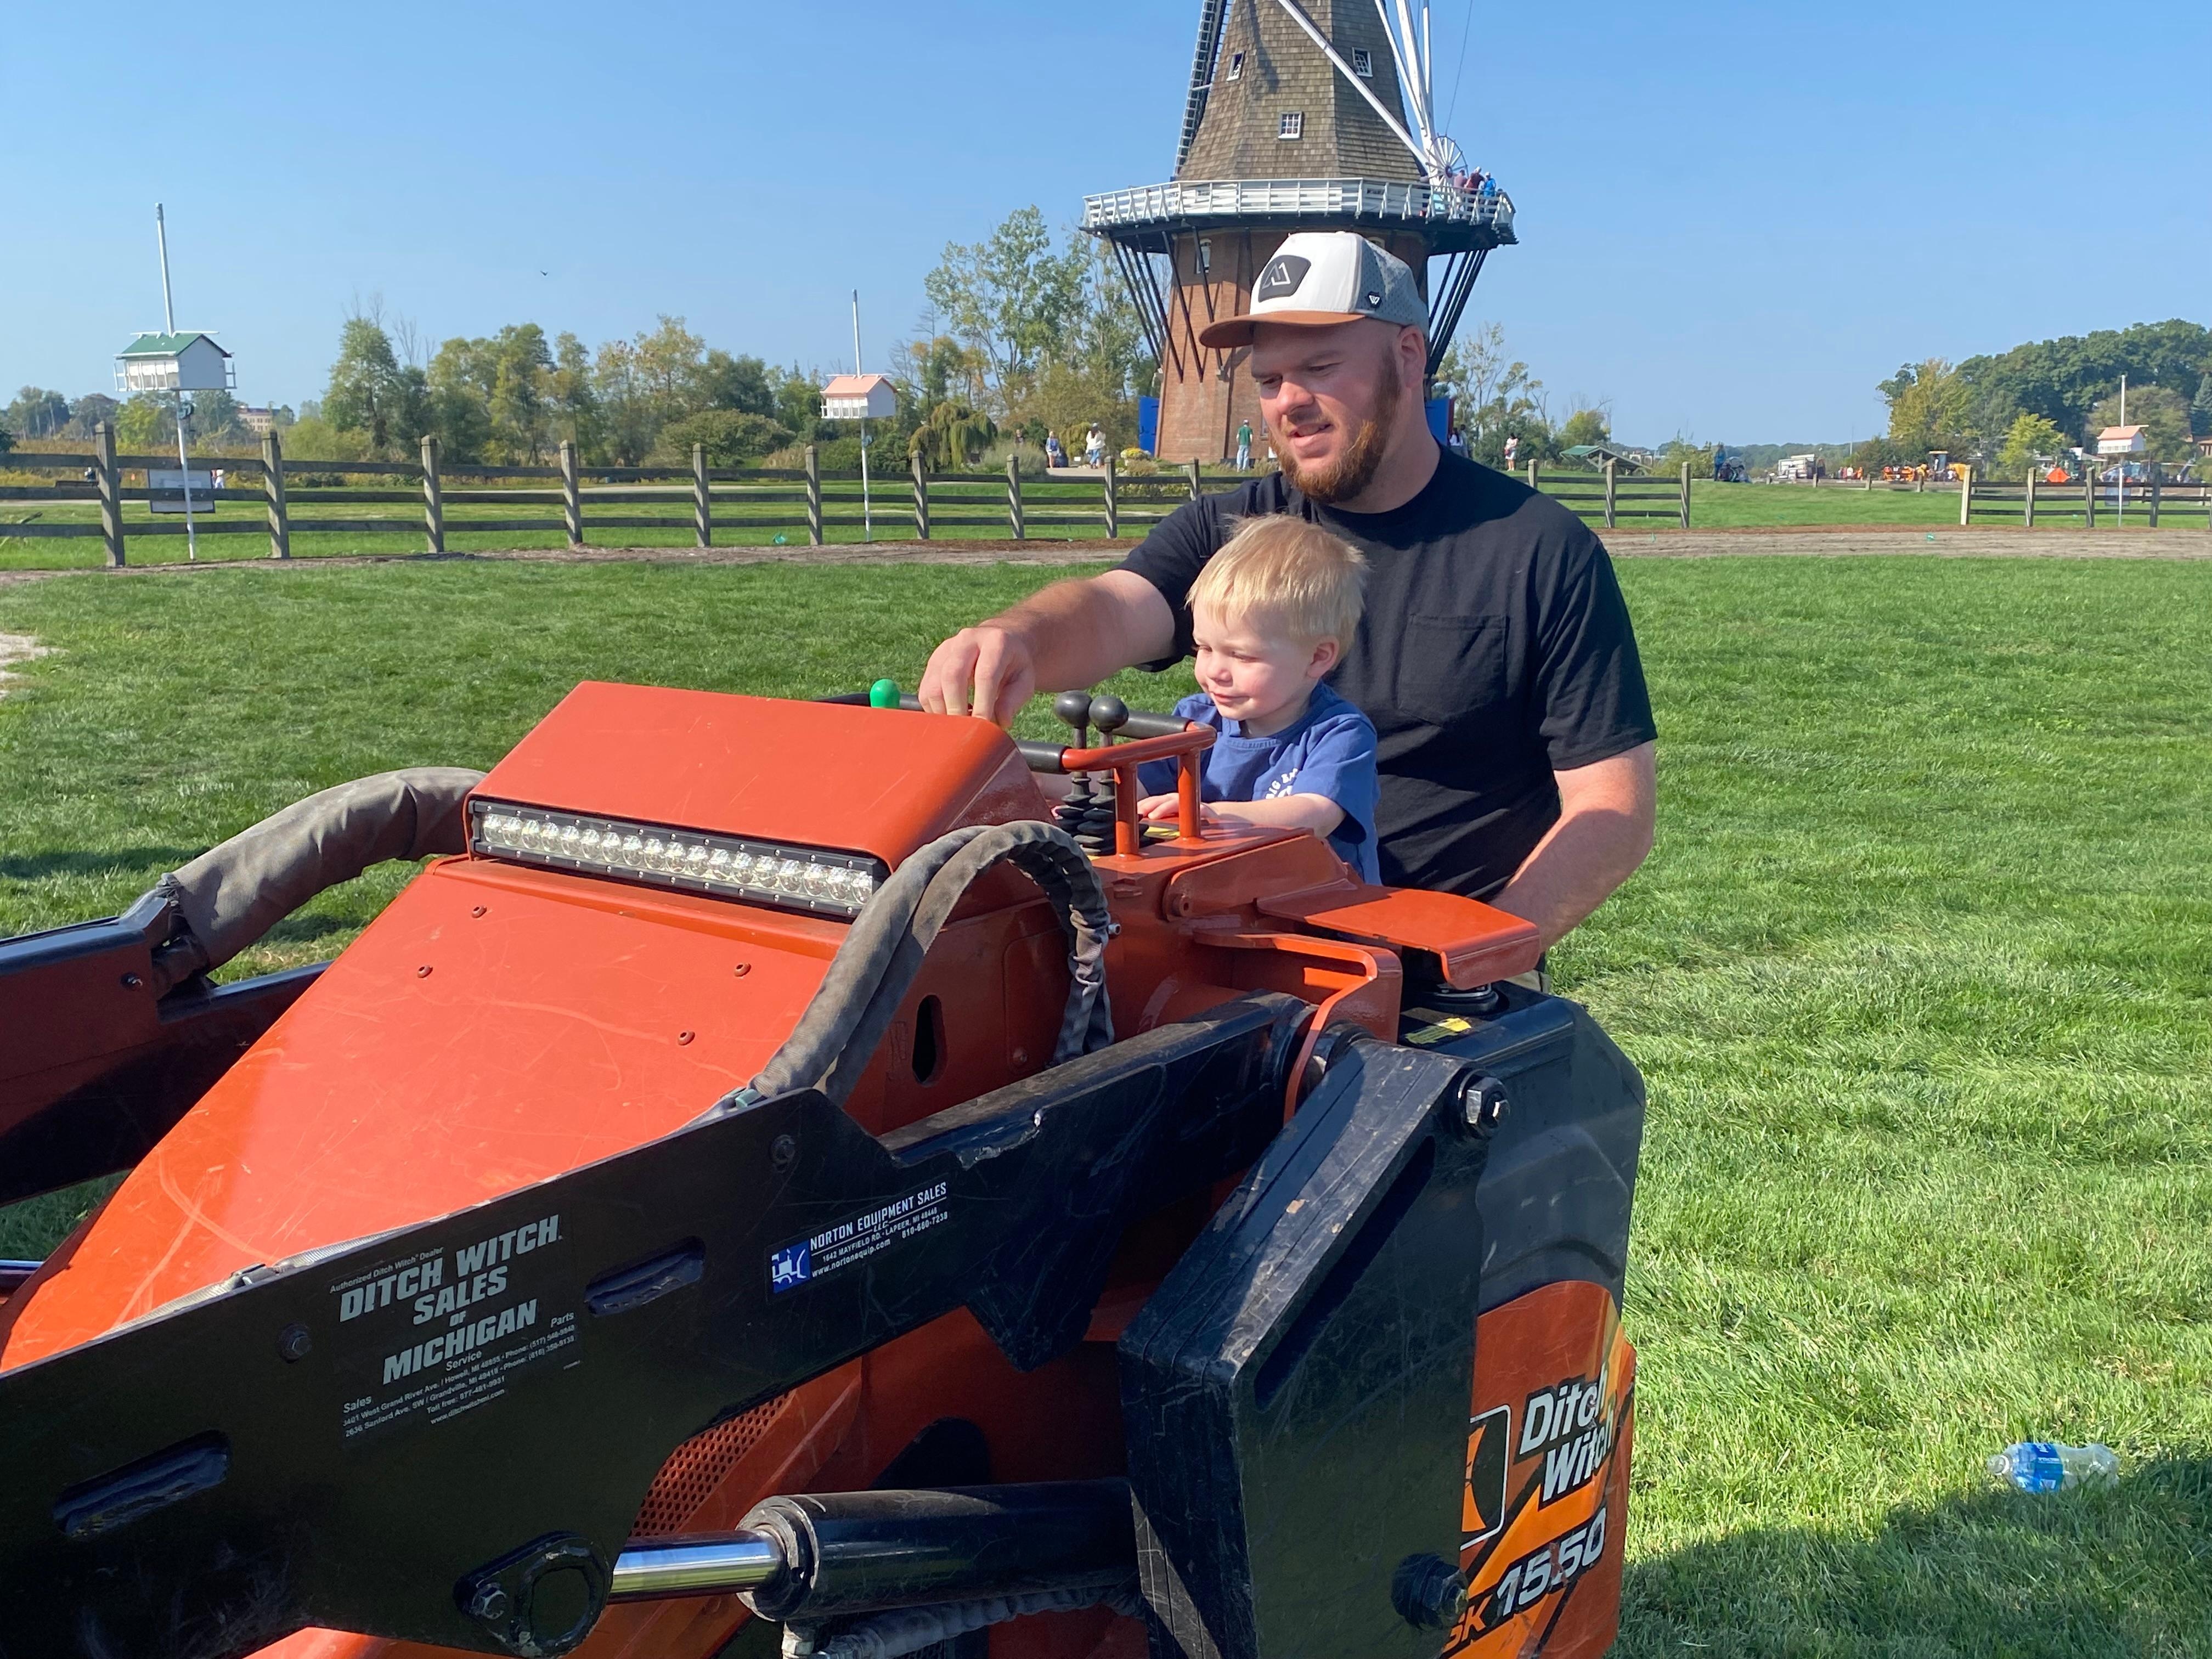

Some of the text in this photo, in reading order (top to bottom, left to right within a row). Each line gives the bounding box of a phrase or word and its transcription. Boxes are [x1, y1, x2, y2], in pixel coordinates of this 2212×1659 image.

[810, 1181, 947, 1251] NORTON EQUIPMENT SALES
[838, 1237, 870, 1256] MAYFIELD
[330, 1272, 372, 1294] Authorized
[373, 1265, 393, 1278] Ditch
[420, 1247, 444, 1261] Dealer
[340, 1214, 560, 1323] DITCH WITCH
[811, 1238, 891, 1278] www.nortonequip.com
[413, 1266, 508, 1325] SALES
[449, 1311, 466, 1327] OF
[343, 1312, 574, 1414] Sales Service Parts
[383, 1299, 538, 1385] MICHIGAN
[361, 1406, 380, 1419] West
[381, 1396, 404, 1411] Grand
[404, 1389, 423, 1401] River
[412, 1399, 425, 1409] SW
[1520, 1361, 1609, 1455] Ditch
[1542, 1402, 1615, 1502] Witch
[1497, 1506, 1607, 1616] 1550
